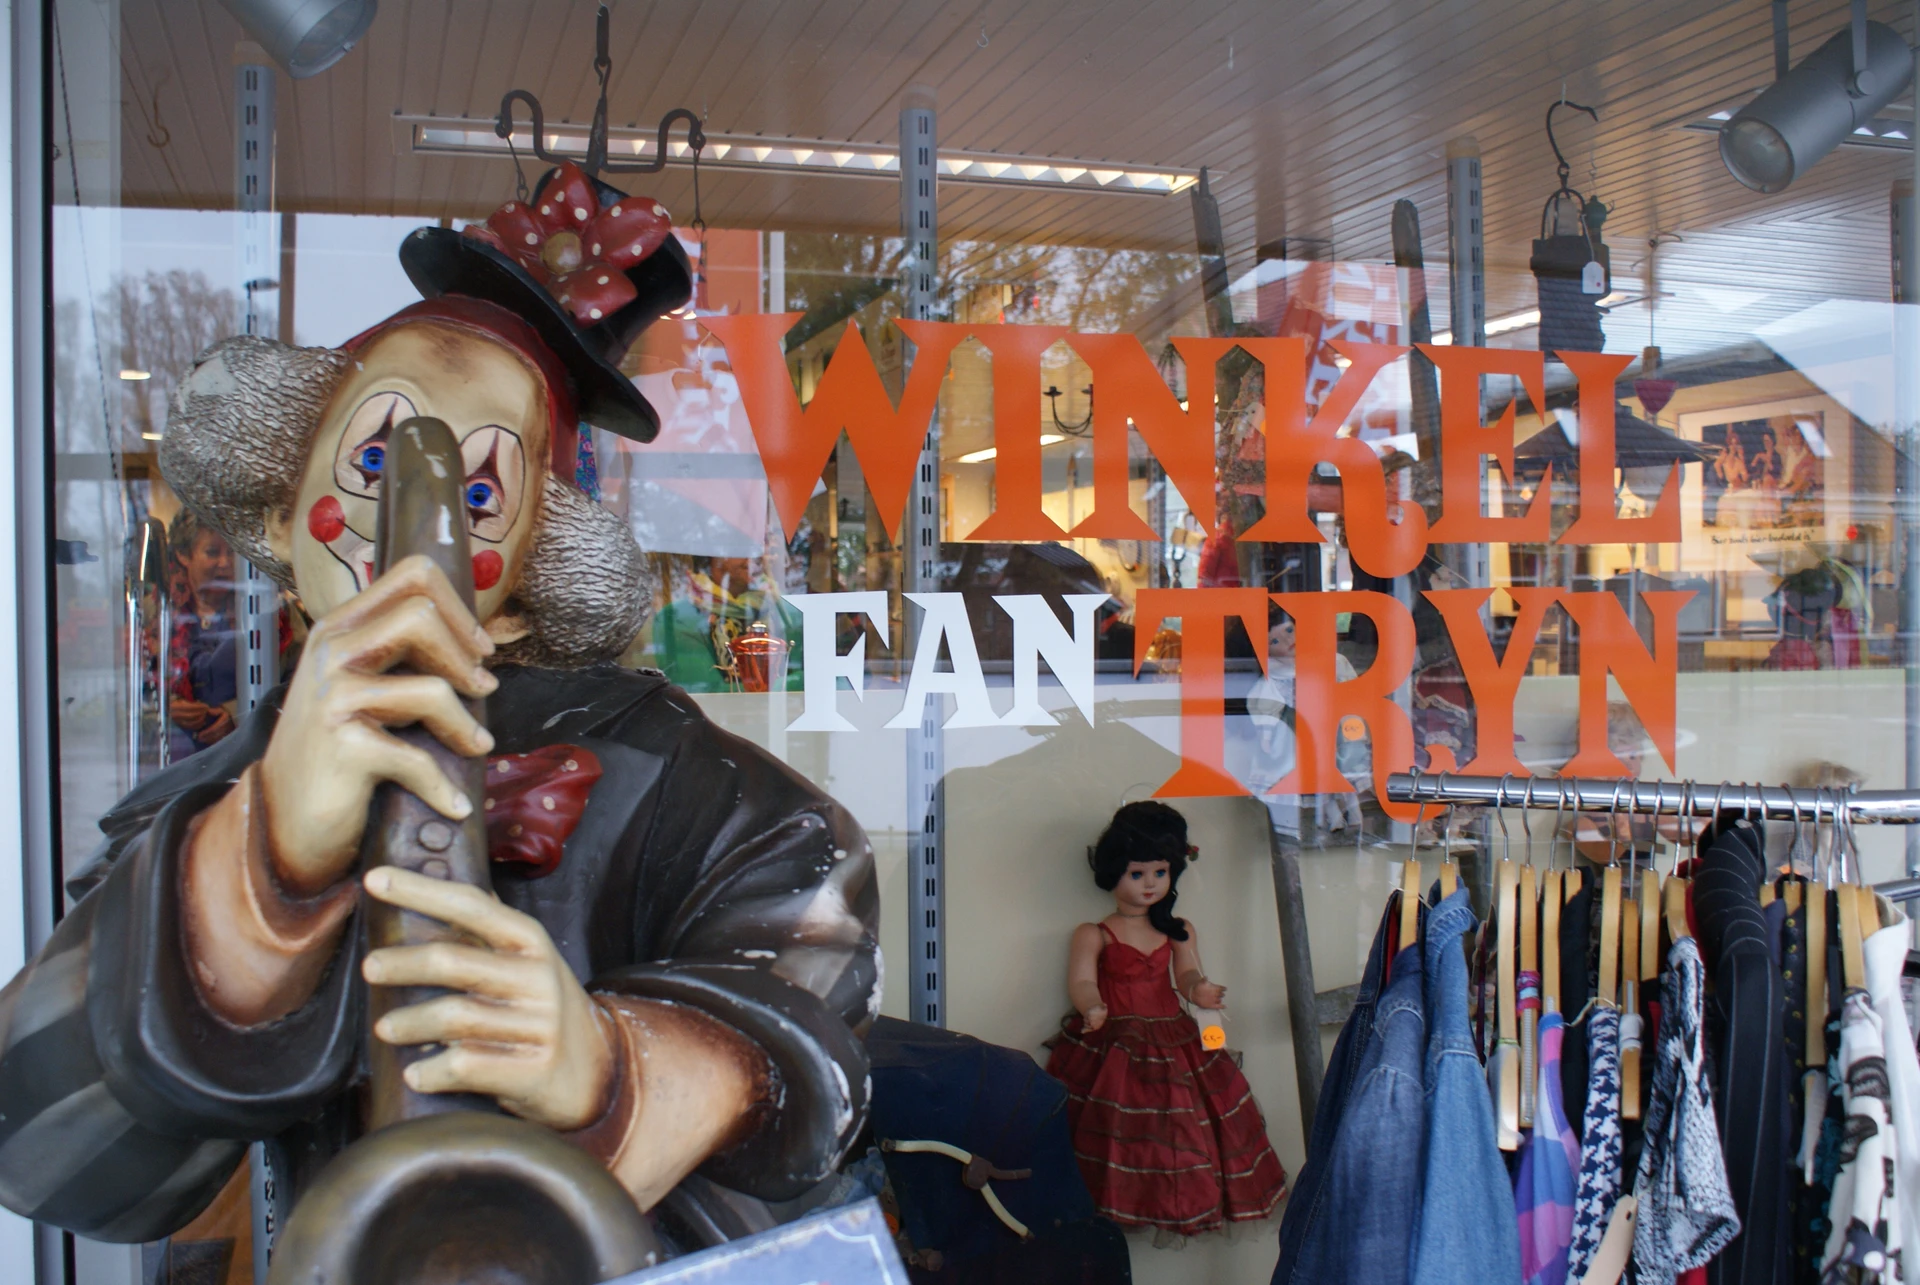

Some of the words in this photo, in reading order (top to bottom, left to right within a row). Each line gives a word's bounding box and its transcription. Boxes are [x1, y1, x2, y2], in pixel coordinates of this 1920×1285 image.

[697, 312, 1682, 578] WINKEL
[782, 591, 1112, 732] FAN
[1134, 587, 1698, 823] TRYN
